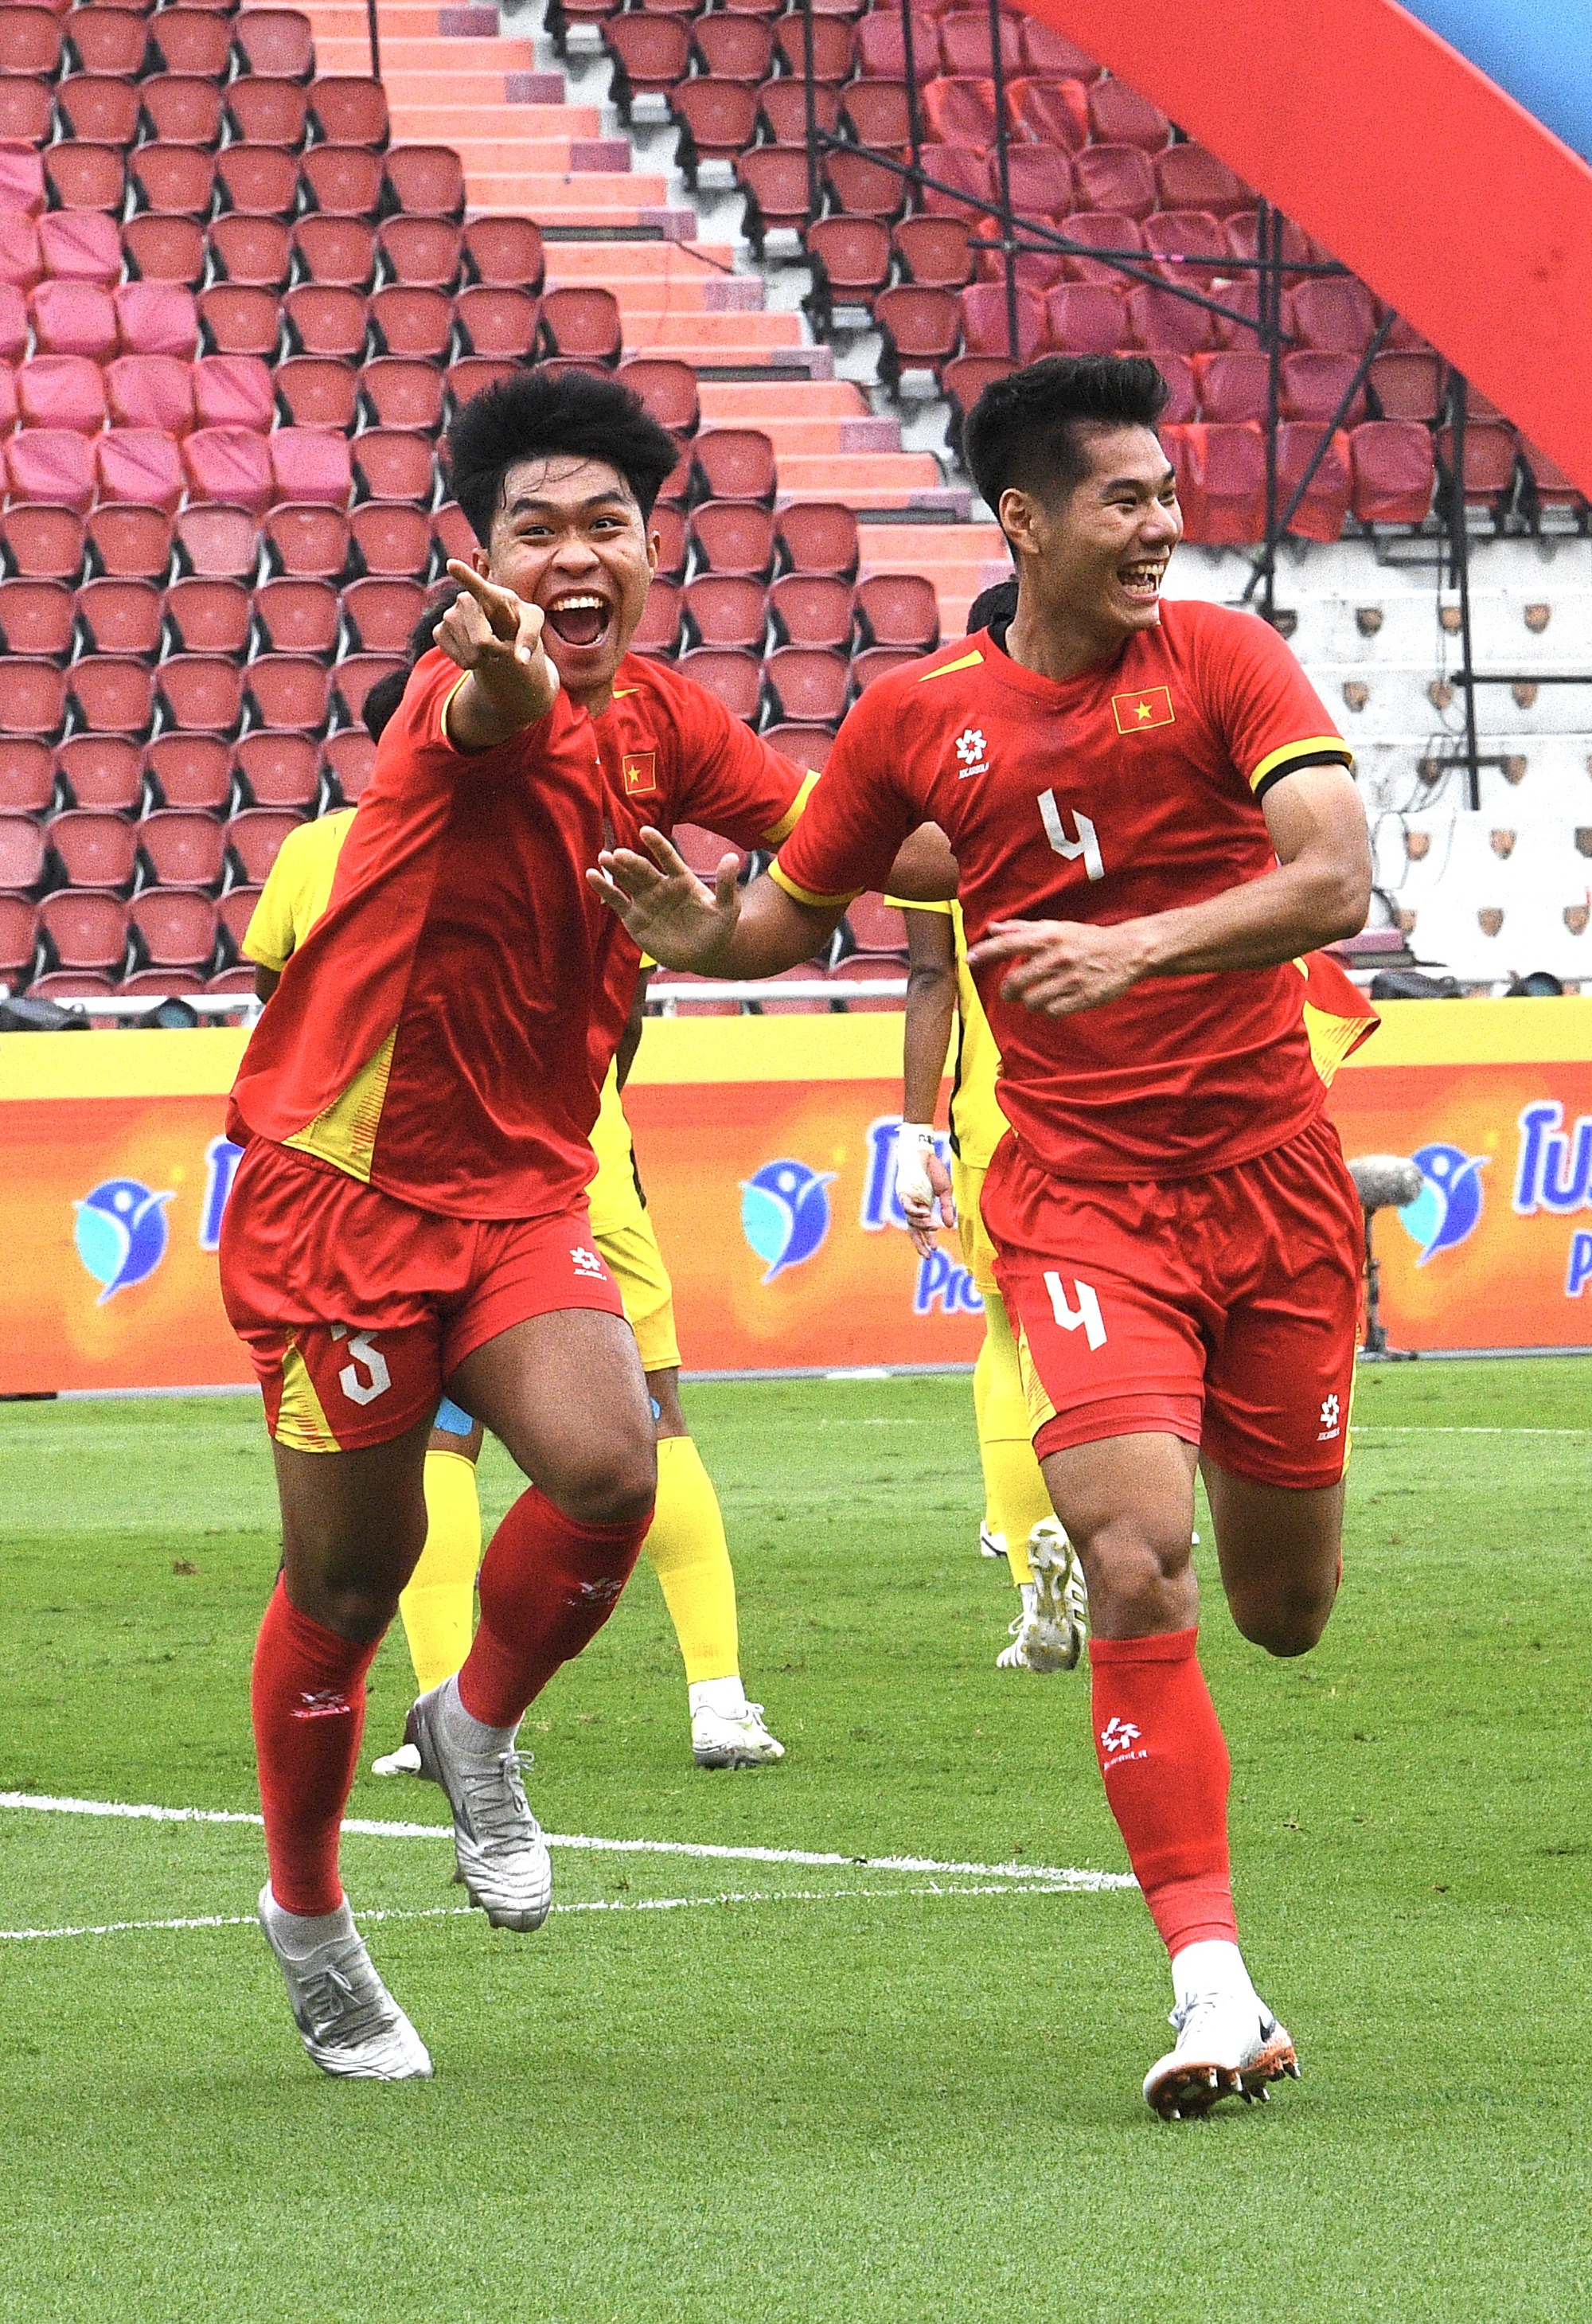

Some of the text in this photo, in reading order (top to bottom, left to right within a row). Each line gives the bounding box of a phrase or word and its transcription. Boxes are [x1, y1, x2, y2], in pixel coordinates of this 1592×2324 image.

[1036, 787, 1105, 881] 4
[1042, 1271, 1108, 1352] 4
[330, 1322, 392, 1407] 3
